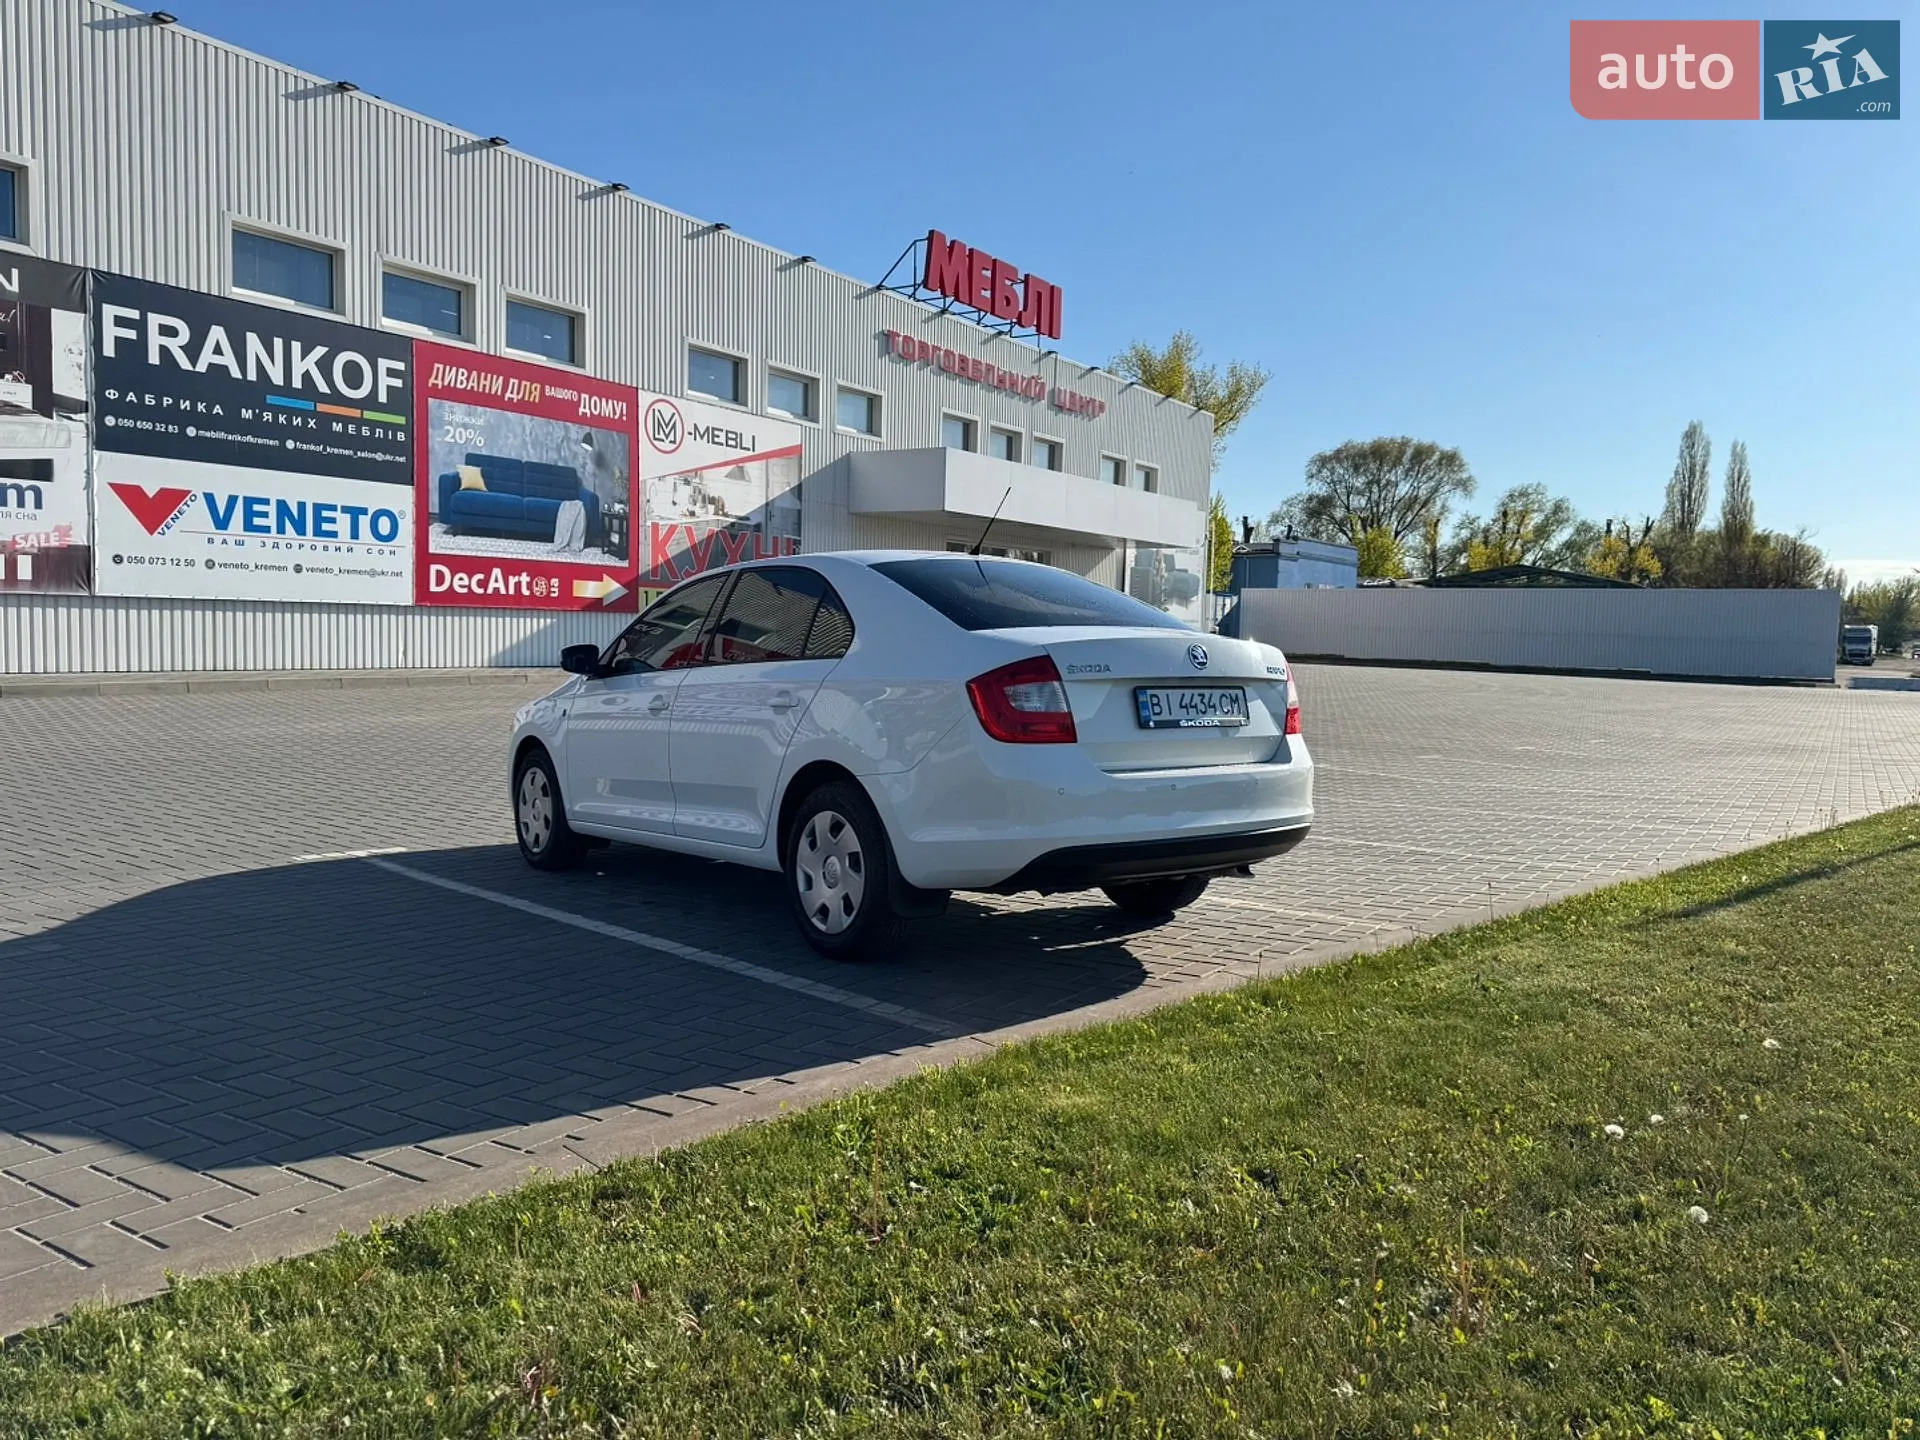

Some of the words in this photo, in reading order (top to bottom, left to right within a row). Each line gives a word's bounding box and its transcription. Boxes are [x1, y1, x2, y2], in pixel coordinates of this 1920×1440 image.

[923, 229, 1063, 340] МЕБЛІ
[101, 303, 406, 404] FRANKOF
[428, 363, 503, 396] ДИВАНИ
[505, 378, 541, 403] ДЛЯ
[545, 385, 578, 402] ВАШОГО
[579, 393, 627, 421] ДОМУ!
[886, 329, 1047, 401] ТОРГОВЕЛЬНИЙ
[1055, 387, 1107, 419] ЦЕНТР
[105, 388, 224, 416] ФАБРИКА
[241, 407, 317, 429] М'ЯКИХ
[332, 422, 406, 441] МЕБЛІВ
[117, 418, 135, 428] 050
[136, 420, 153, 430] 650
[155, 423, 166, 432] 32
[167, 424, 179, 434] 83
[157, 493, 198, 537] VENETO
[202, 491, 399, 543] VENETO
[15, 532, 60, 549] SALE
[207, 537, 245, 547] ВАШ
[260, 541, 354, 554] ЗДОРОВИЙ
[366, 547, 396, 557] СОН
[126, 555, 146, 565] 050
[148, 556, 167, 566] 073
[170, 557, 181, 567] 12
[184, 558, 196, 567] 50
[217, 561, 288, 572] veneto_kremen
[305, 565, 404, 578] veneto_kremen@ukr.net
[429, 564, 531, 596] DecArt
